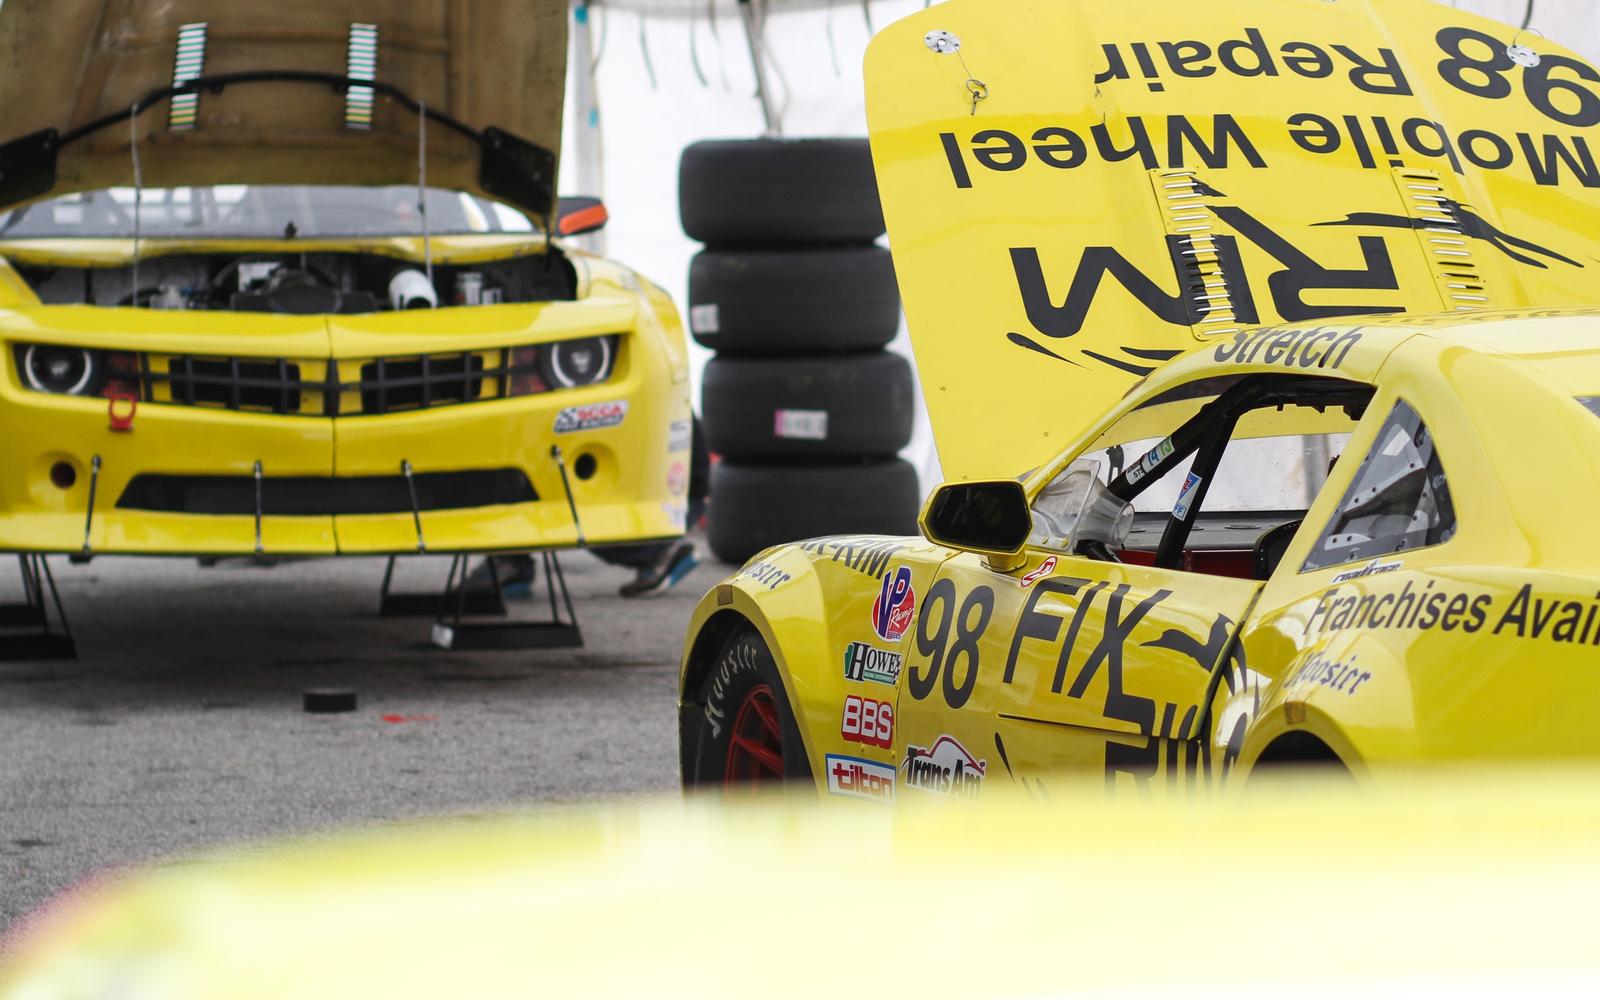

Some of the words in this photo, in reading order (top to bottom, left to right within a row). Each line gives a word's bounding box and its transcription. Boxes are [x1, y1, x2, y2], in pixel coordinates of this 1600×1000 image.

[1094, 27, 1414, 96] Repair
[1436, 27, 1600, 127] 98
[939, 113, 1268, 188] Wheel
[1289, 112, 1600, 188] Mobile
[1214, 326, 1364, 368] Stretch
[877, 567, 911, 638] VP
[1003, 576, 1174, 699] FIX
[1303, 580, 1492, 636] Franchises
[908, 578, 995, 709] 98
[842, 696, 893, 741] BBS
[832, 762, 893, 800] tilton
[907, 747, 950, 792] Trans
